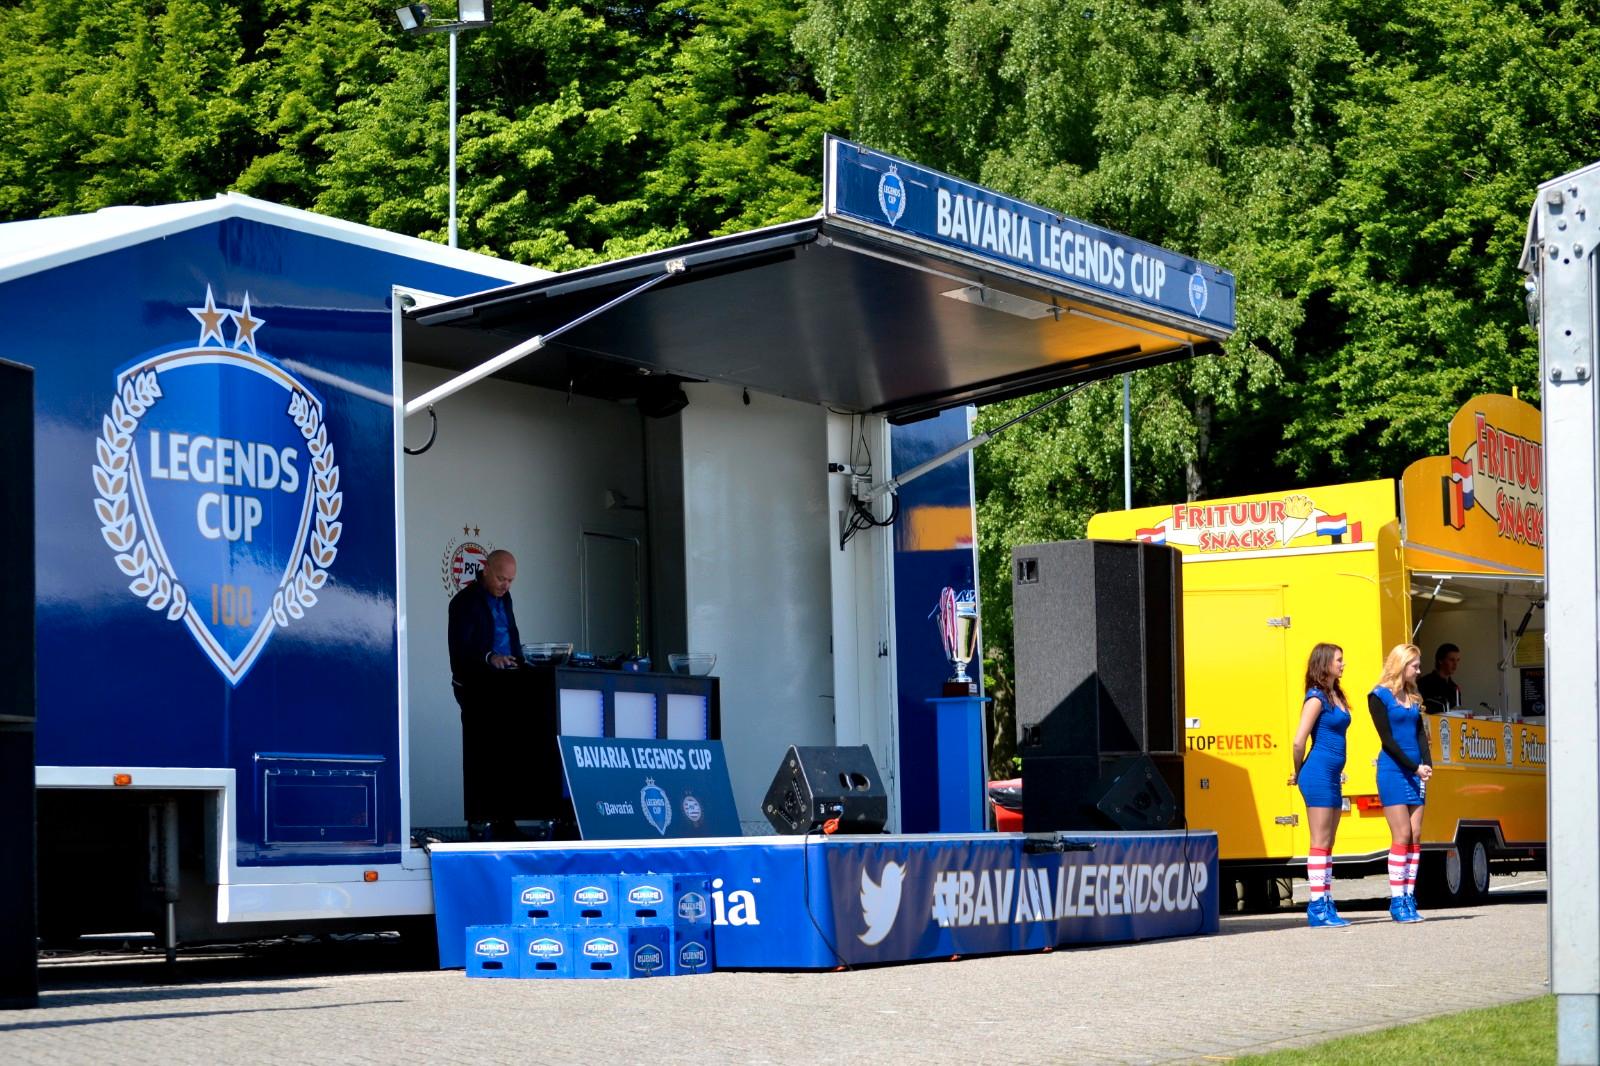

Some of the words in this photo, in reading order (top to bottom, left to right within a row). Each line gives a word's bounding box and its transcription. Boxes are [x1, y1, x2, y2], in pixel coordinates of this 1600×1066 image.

[937, 188, 1034, 262] BAVARIA
[1040, 222, 1125, 290] LEGENDS
[1130, 253, 1166, 300] CUP
[150, 431, 299, 493] LEGENDS
[1475, 411, 1544, 495] FRITUU
[197, 492, 263, 542] CUP
[1172, 501, 1288, 530] FRITUUR
[1199, 529, 1276, 551] SNACKS
[464, 562, 480, 575] PSV
[211, 583, 253, 627] 100
[1460, 722, 1498, 760] Frituur
[1521, 728, 1546, 763] Fritu
[573, 745, 631, 768] BAVARIA
[631, 747, 686, 770] LEGENDS
[688, 749, 712, 770] CUP
[604, 801, 634, 815] Bavaria
[525, 892, 551, 900] Bavaria
[578, 892, 604, 900] Bavaria
[632, 891, 659, 899] Bavaria
[479, 943, 505, 952] Bavaria
[533, 944, 559, 952] Bavaria
[587, 943, 614, 952] Bavaria
[637, 952, 660, 965] Bavaria
